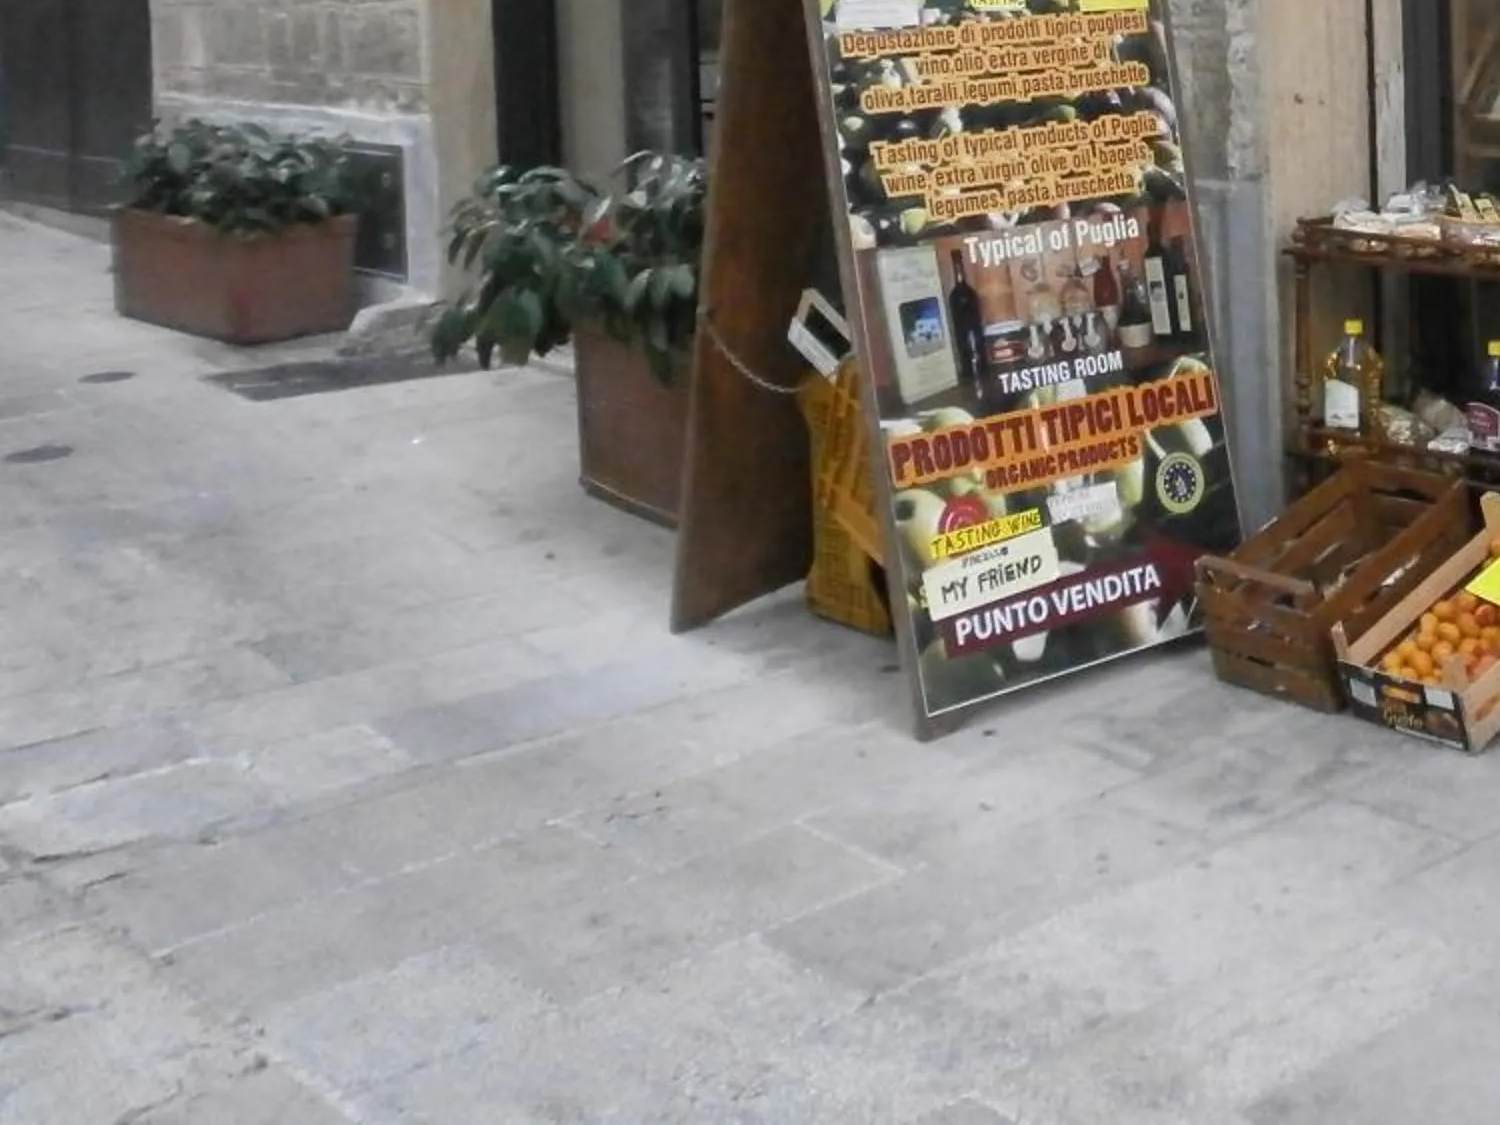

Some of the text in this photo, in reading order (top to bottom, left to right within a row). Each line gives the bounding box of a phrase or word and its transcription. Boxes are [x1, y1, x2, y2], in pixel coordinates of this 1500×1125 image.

[842, 12, 1145, 55] Degustazione di prodotti tipici pugliesi
[989, 49, 1028, 67] extra
[1034, 45, 1089, 67] vergine
[1093, 41, 1107, 59] di
[875, 115, 1157, 166] Tasting of typical products of Puglia
[936, 166, 976, 186] extra
[980, 160, 1026, 187] virgin
[1031, 155, 1068, 174] olive
[964, 213, 1140, 267] Typical of Puglia
[1000, 351, 1124, 394] TASTING ROOM
[891, 375, 1215, 478] PRODOTTI TIPICI LOCALI
[1058, 437, 1138, 474] PRODUCTS
[932, 510, 1041, 559] TASTING WINE
[941, 579, 967, 605] MY
[956, 564, 1161, 646] PUNTO VENDITA
